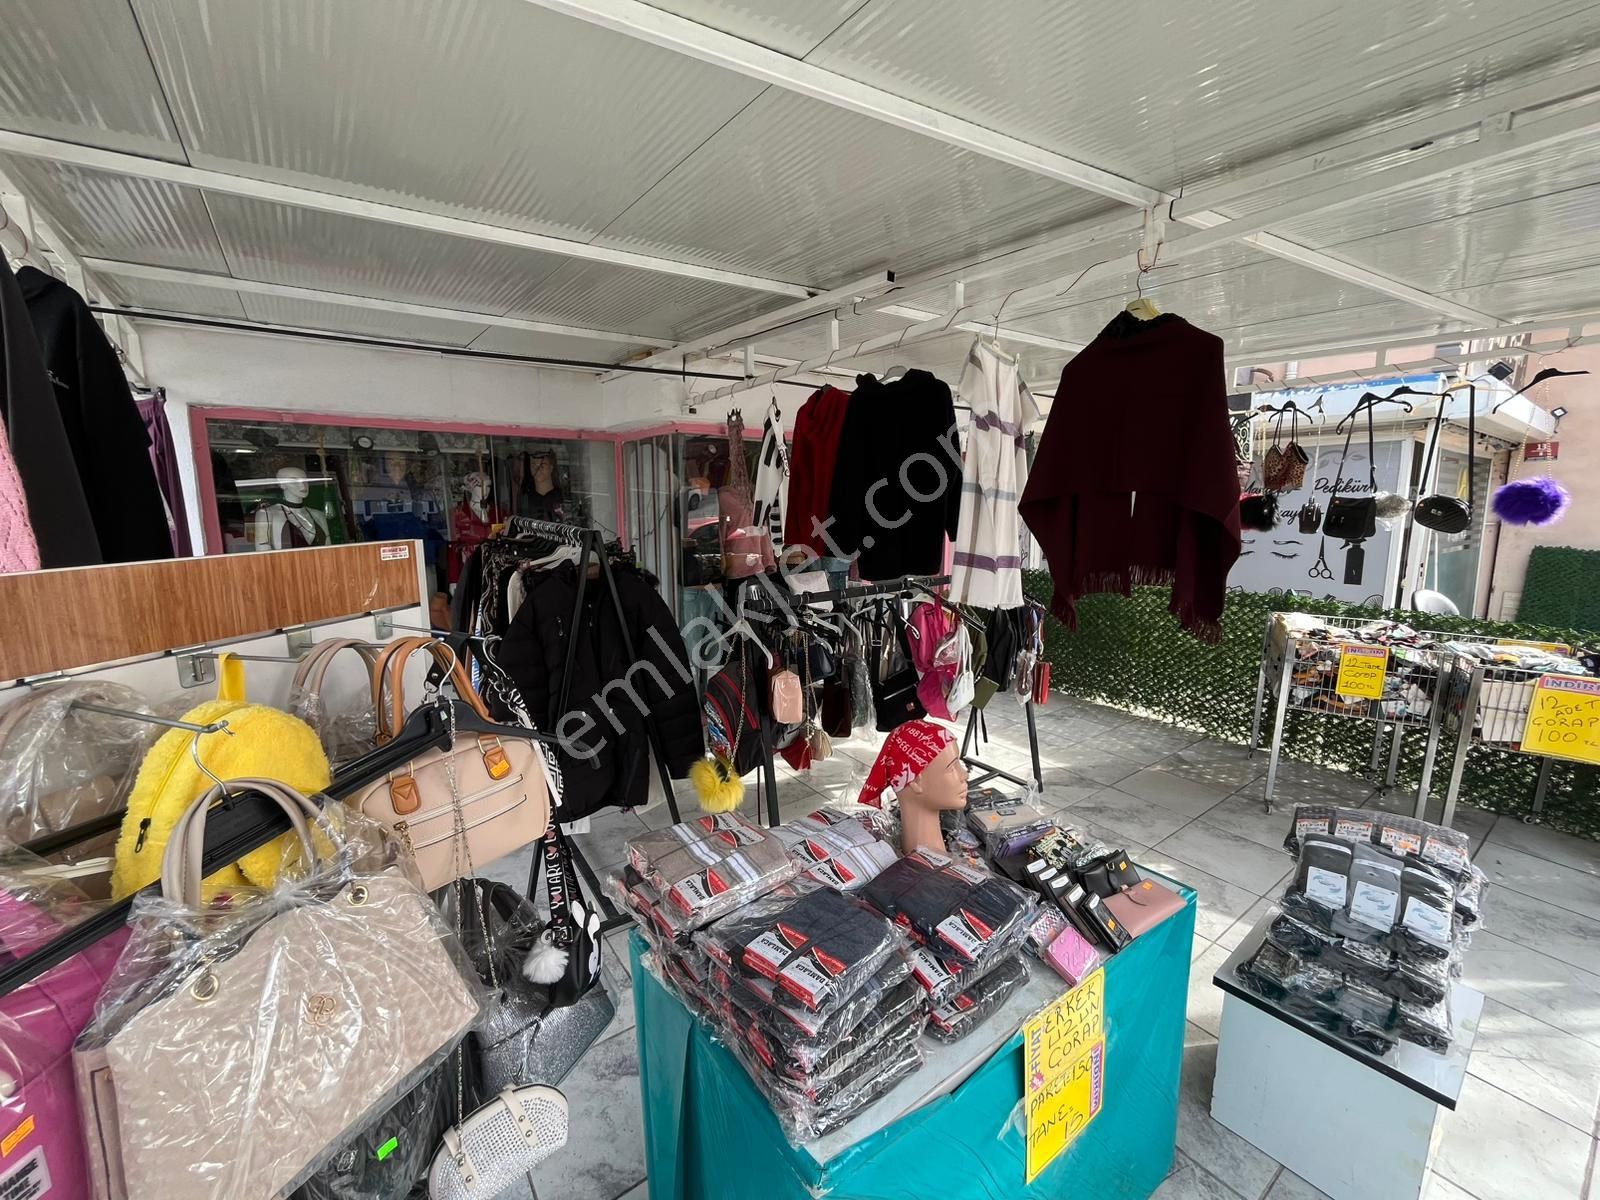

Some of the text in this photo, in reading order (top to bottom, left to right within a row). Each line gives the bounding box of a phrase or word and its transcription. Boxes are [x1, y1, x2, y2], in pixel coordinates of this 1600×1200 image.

[1541, 695, 1568, 711] 12
[1539, 729, 1578, 743] 100
[760, 937, 789, 956] DAMLACA
[795, 963, 826, 984] DAMLACA
[1045, 982, 1096, 1034] ERKEK
